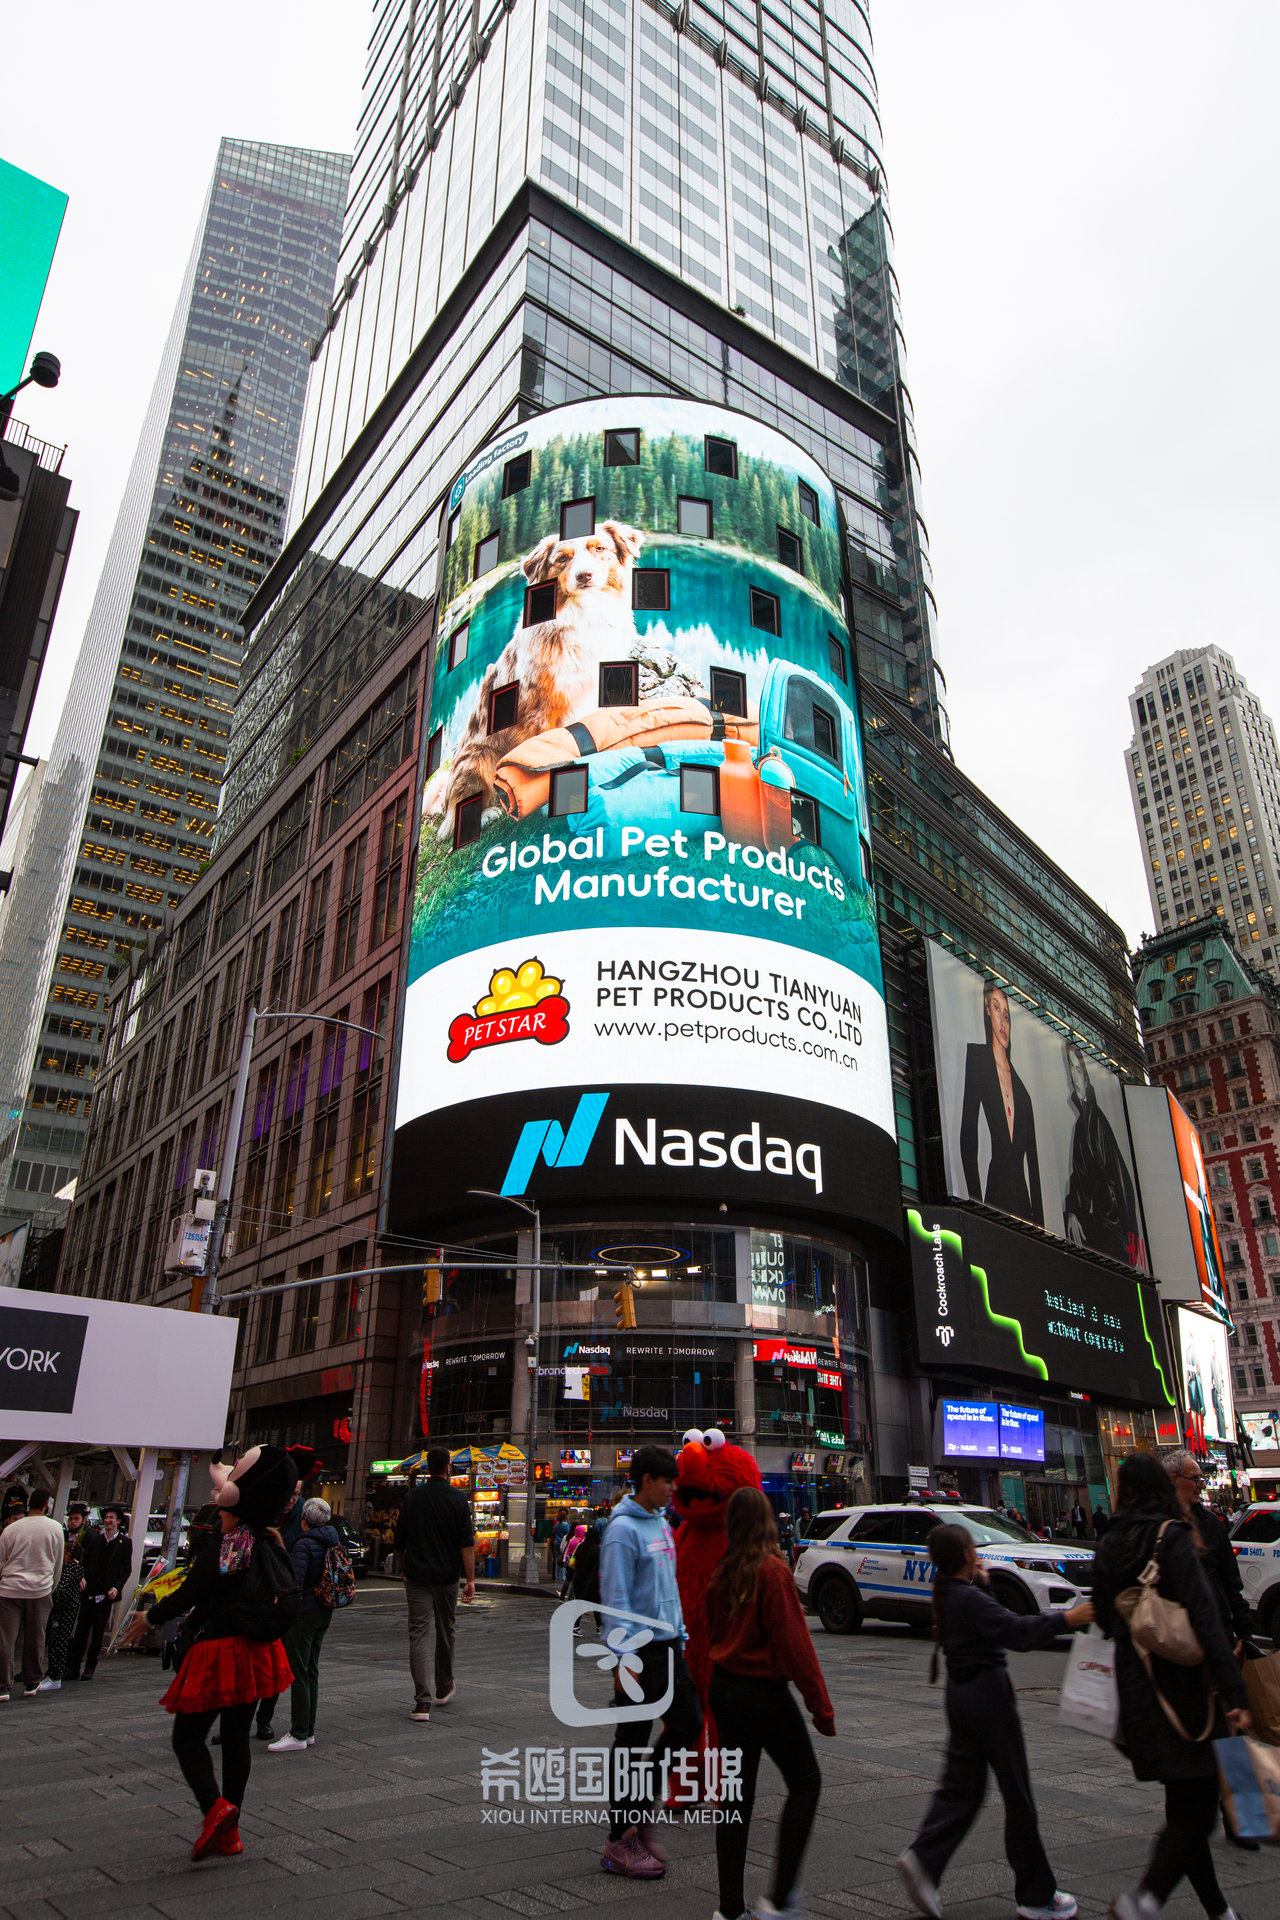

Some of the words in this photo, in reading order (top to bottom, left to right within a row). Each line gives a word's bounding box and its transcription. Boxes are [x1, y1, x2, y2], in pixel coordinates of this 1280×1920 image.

[493, 435, 525, 459] factory
[482, 826, 603, 879] Global
[621, 826, 689, 859] Pet
[705, 831, 846, 902] Products
[535, 865, 807, 920] Manufacturer
[596, 988, 639, 1008] PET
[653, 988, 790, 1021] PRODUCTS
[797, 1008, 863, 1047] CO.,LTD
[597, 960, 760, 990] HANGZHOU
[769, 973, 862, 1024] TIANYUAN
[463, 1021, 495, 1046] PET
[496, 1012, 547, 1038] STAR
[595, 1021, 859, 1072] www.petproducts.com.cn
[615, 1118, 824, 1195] Nasdaq
[931, 1223, 942, 1251] Labs
[934, 1253, 948, 1317] Cockroach
[578, 1345, 611, 1356] Nasdaq
[626, 1346, 664, 1356] REWRITE
[667, 1347, 715, 1357] TOMORROW
[622, 1406, 669, 1421] Nasdaq
[982, 1553, 1005, 1561] POLICE
